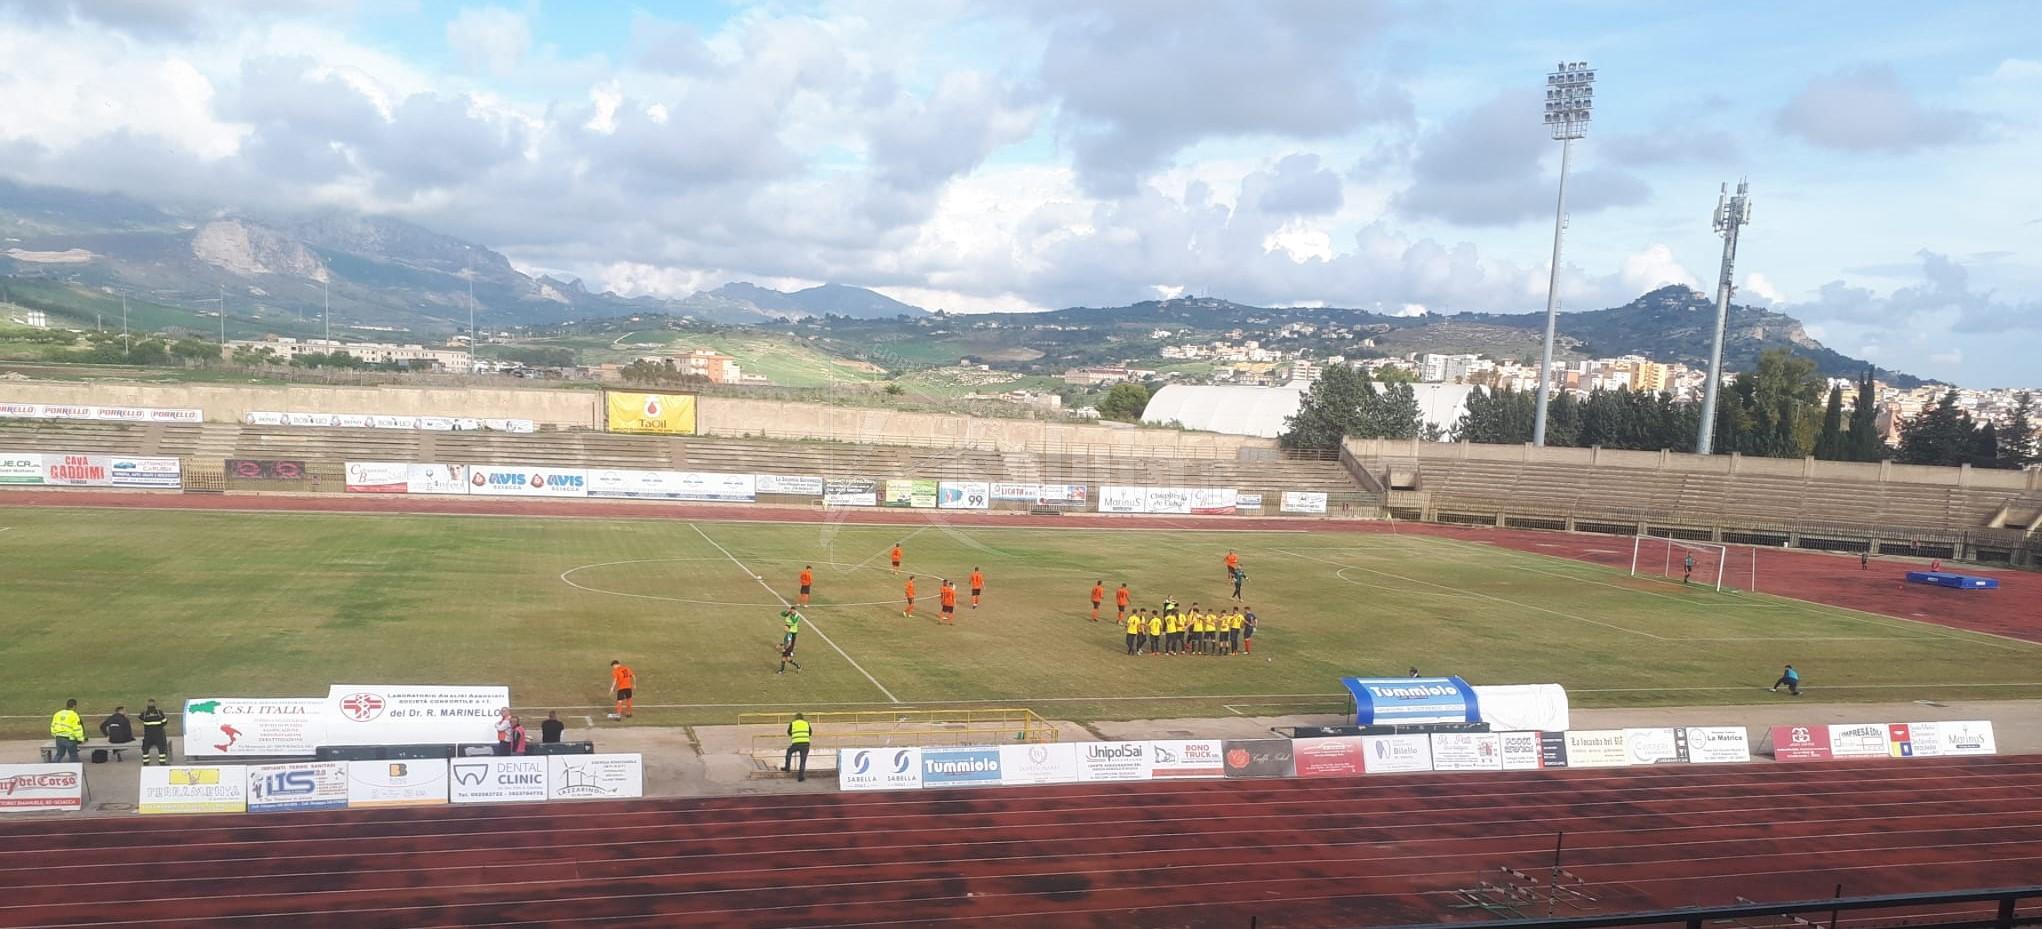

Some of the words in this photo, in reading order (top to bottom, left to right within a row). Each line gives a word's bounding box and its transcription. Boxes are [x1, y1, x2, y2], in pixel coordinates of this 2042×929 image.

[65, 456, 88, 465] CAVA
[489, 473, 526, 485] AVIS
[547, 474, 584, 487] AVIS
[1370, 685, 1457, 698] Tummiolo
[259, 705, 306, 714] ITALIA
[390, 709, 405, 717] del
[409, 709, 423, 717] Dr.
[426, 709, 437, 717] R.
[440, 708, 501, 717] MARINELLO
[1088, 744, 1142, 762] UnipolSai
[497, 762, 543, 773] DENTAL
[925, 757, 998, 774] Tummiolo
[497, 774, 543, 785] CLINIC
